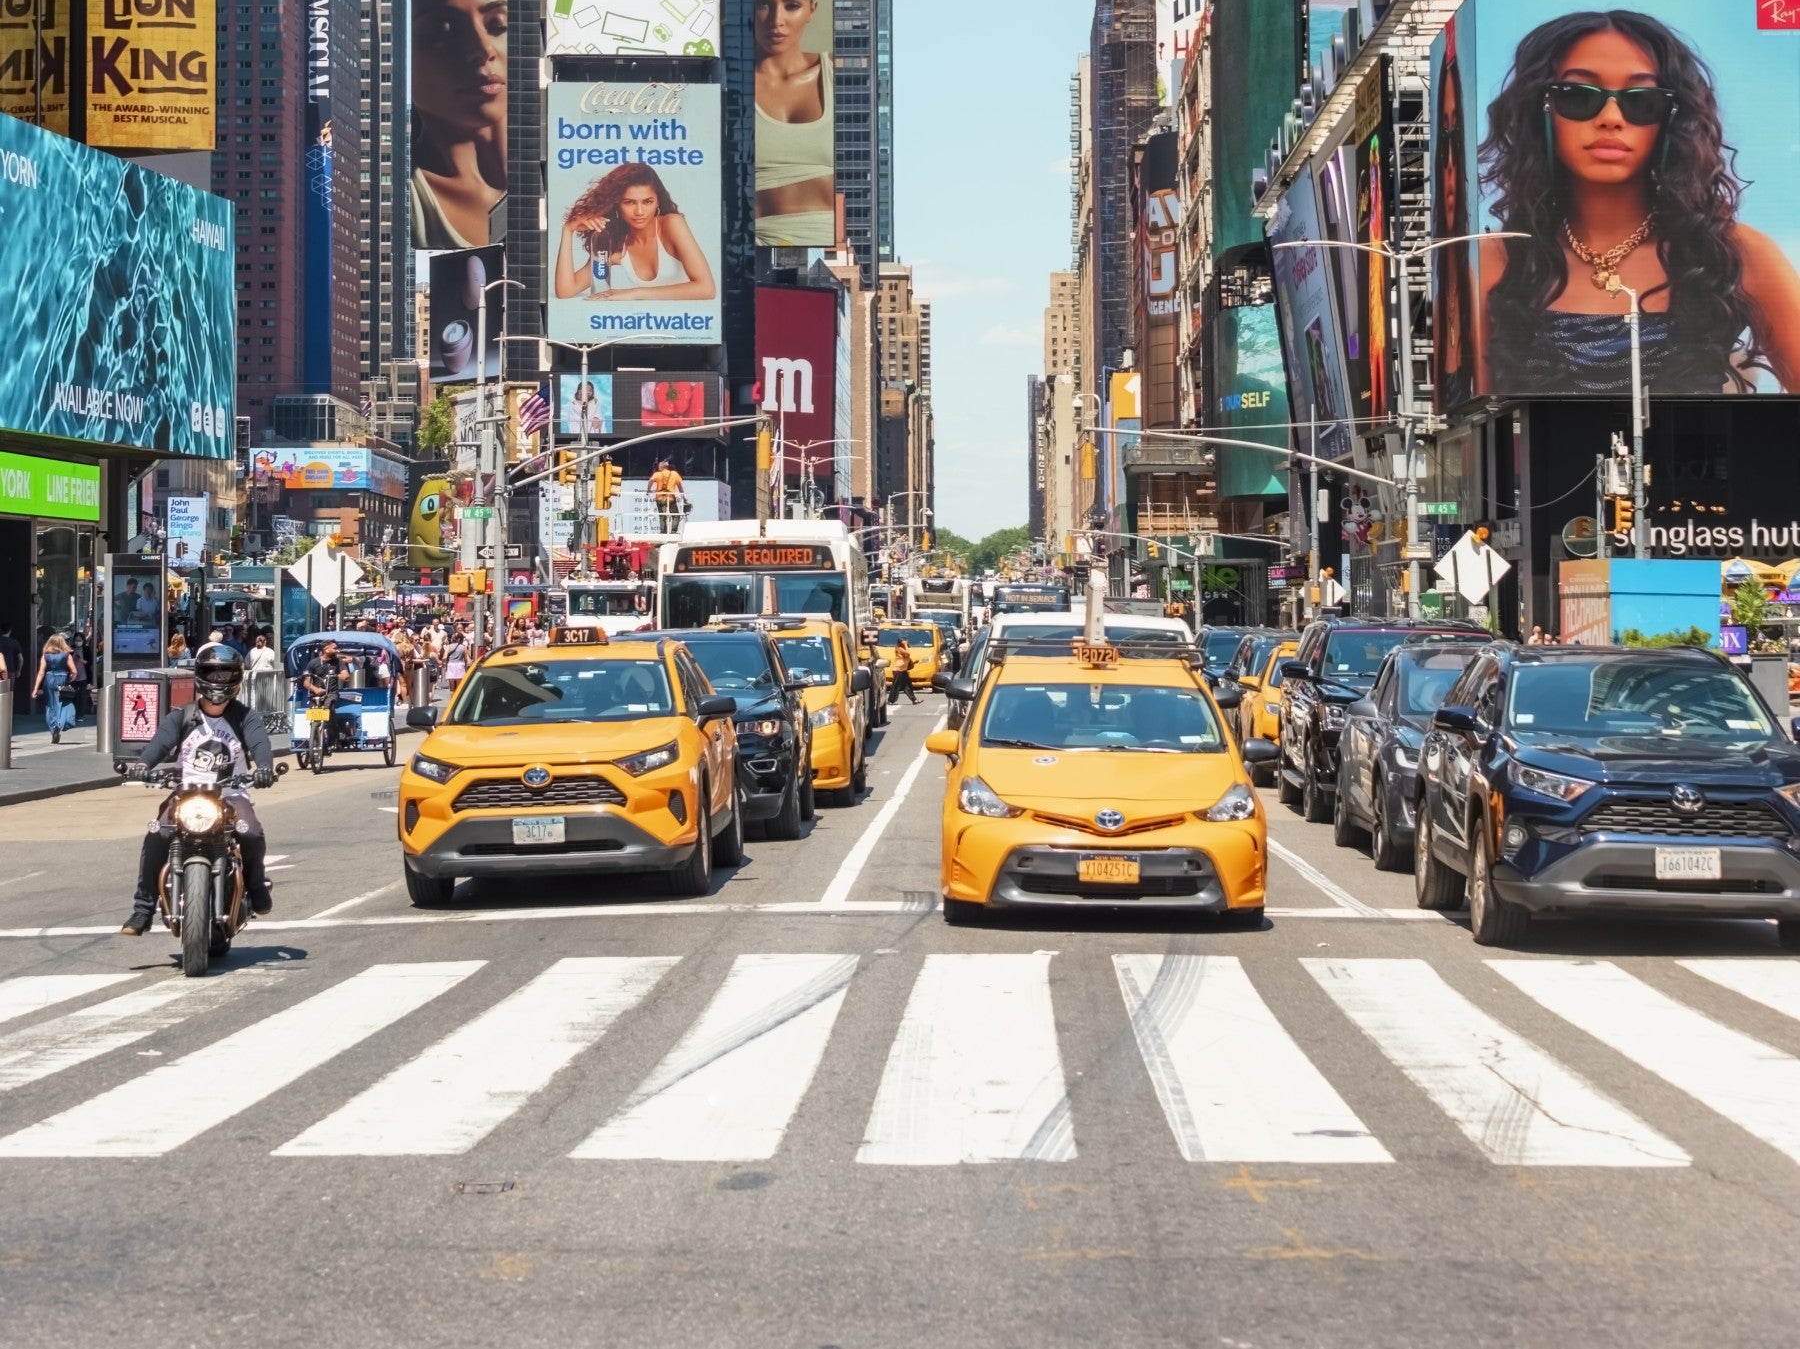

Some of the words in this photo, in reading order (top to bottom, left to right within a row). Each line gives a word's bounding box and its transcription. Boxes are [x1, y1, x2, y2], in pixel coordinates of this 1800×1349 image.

[91, 36, 207, 97] KING
[92, 104, 112, 112] THE
[114, 104, 210, 115] AWARD-WINNING
[113, 115, 137, 123] BEST
[140, 115, 188, 124] MUSICAL
[557, 117, 622, 140] born
[628, 119, 687, 140] with
[557, 146, 630, 170] great
[636, 146, 704, 166] taste
[192, 217, 225, 252] HAWAII
[597, 251, 605, 276] smart
[590, 312, 714, 331] smartwater
[762, 356, 814, 413] m
[55, 381, 113, 420] AVAILABLE
[115, 392, 144, 424] NOW
[1036, 416, 1045, 489] WELLINGTON
[0, 467, 31, 500] YORK
[46, 473, 69, 504] LINE
[70, 477, 99, 507] FRIEN
[170, 499, 190, 507] John
[1427, 503, 1434, 513] W
[1438, 503, 1448, 513] 45
[170, 515, 200, 523] George
[464, 509, 471, 518] W
[474, 508, 484, 517] 45
[170, 522, 194, 530] Ringo
[692, 550, 738, 565] MASKS
[744, 548, 813, 565] REQUIRED
[1005, 594, 1020, 603] NOT
[1030, 595, 1057, 603] SERVICE
[564, 629, 589, 642] 3C17
[1082, 647, 1113, 663] 2072
